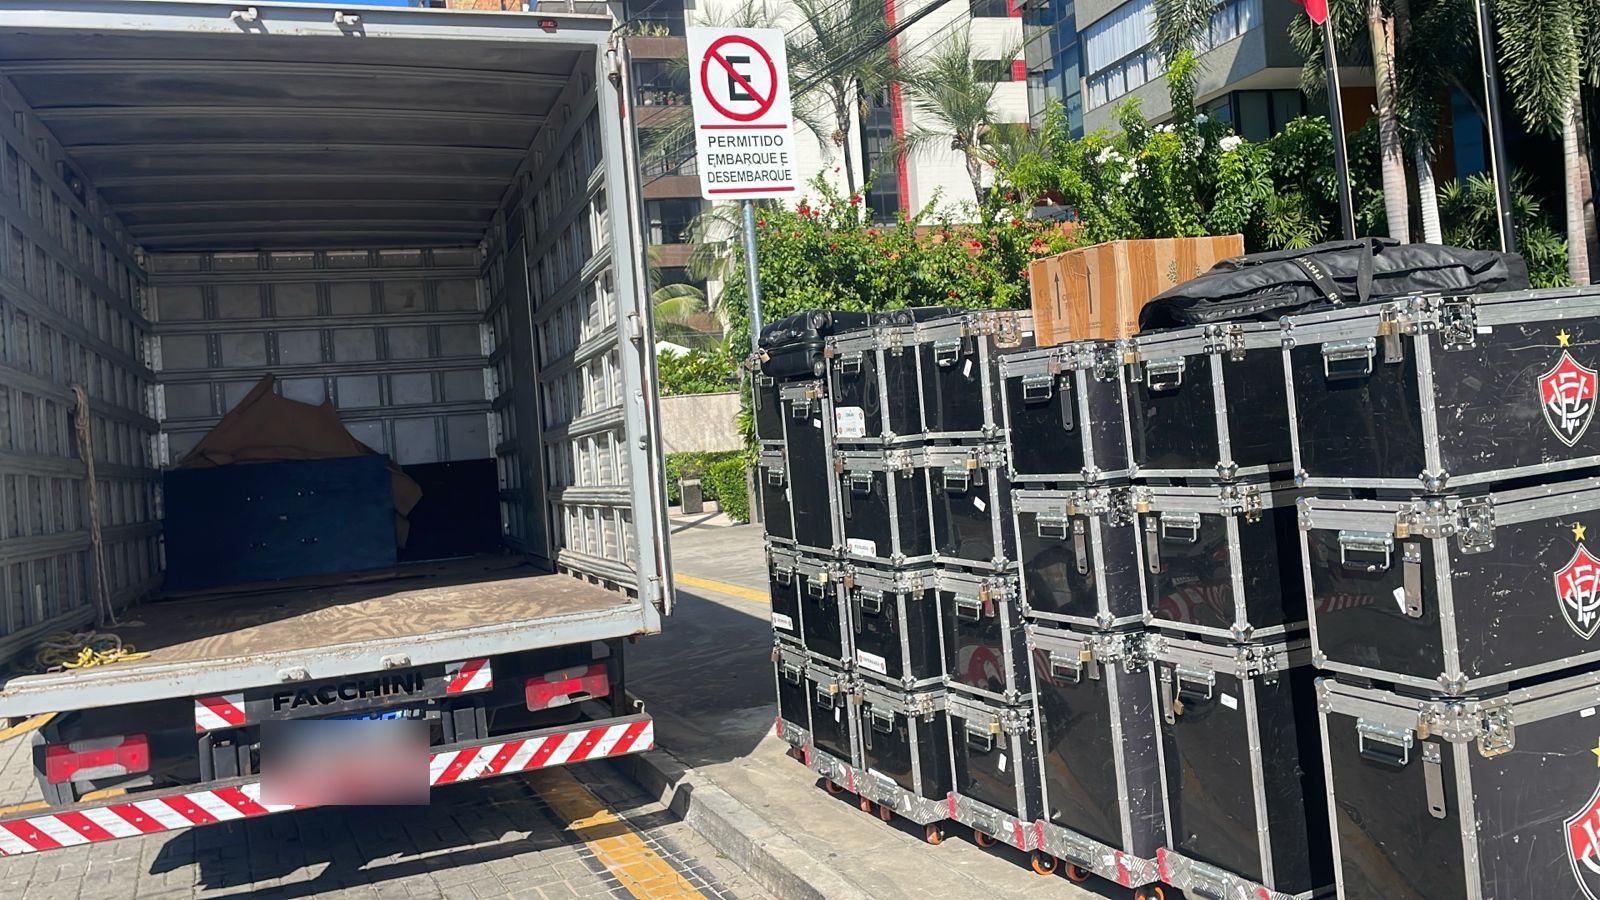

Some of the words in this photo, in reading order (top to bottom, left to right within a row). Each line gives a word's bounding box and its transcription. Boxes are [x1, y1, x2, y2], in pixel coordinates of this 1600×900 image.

[725, 55, 757, 102] E
[707, 134, 784, 148] PERMITIDO
[707, 152, 778, 166] EMBARQUE
[780, 152, 789, 164] E
[707, 169, 793, 183] DESEMBARQUE
[271, 670, 425, 712] FACCHINI
